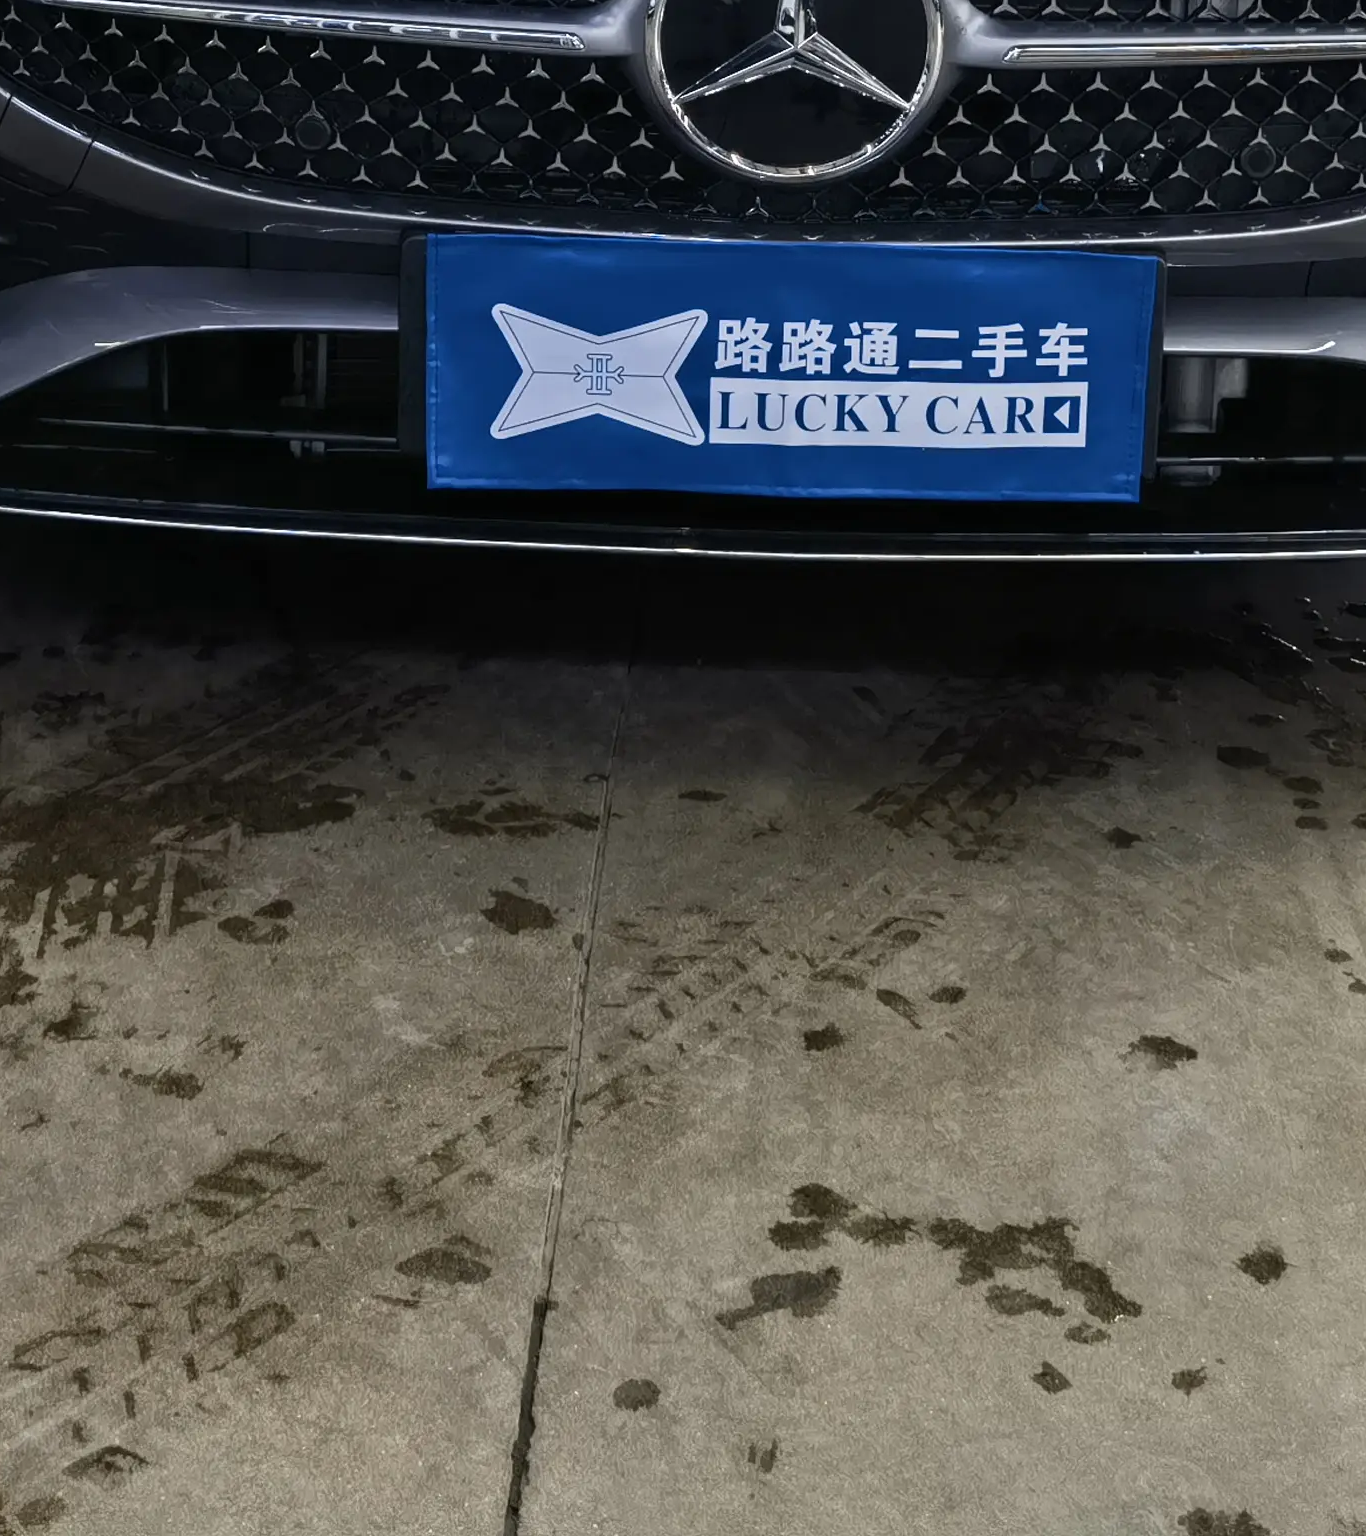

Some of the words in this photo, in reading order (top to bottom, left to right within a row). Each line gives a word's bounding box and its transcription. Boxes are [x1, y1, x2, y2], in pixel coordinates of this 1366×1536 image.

[714, 318, 1088, 378] 路路通二手车
[716, 391, 910, 434] LUCKY
[925, 396, 1037, 435] CAR
